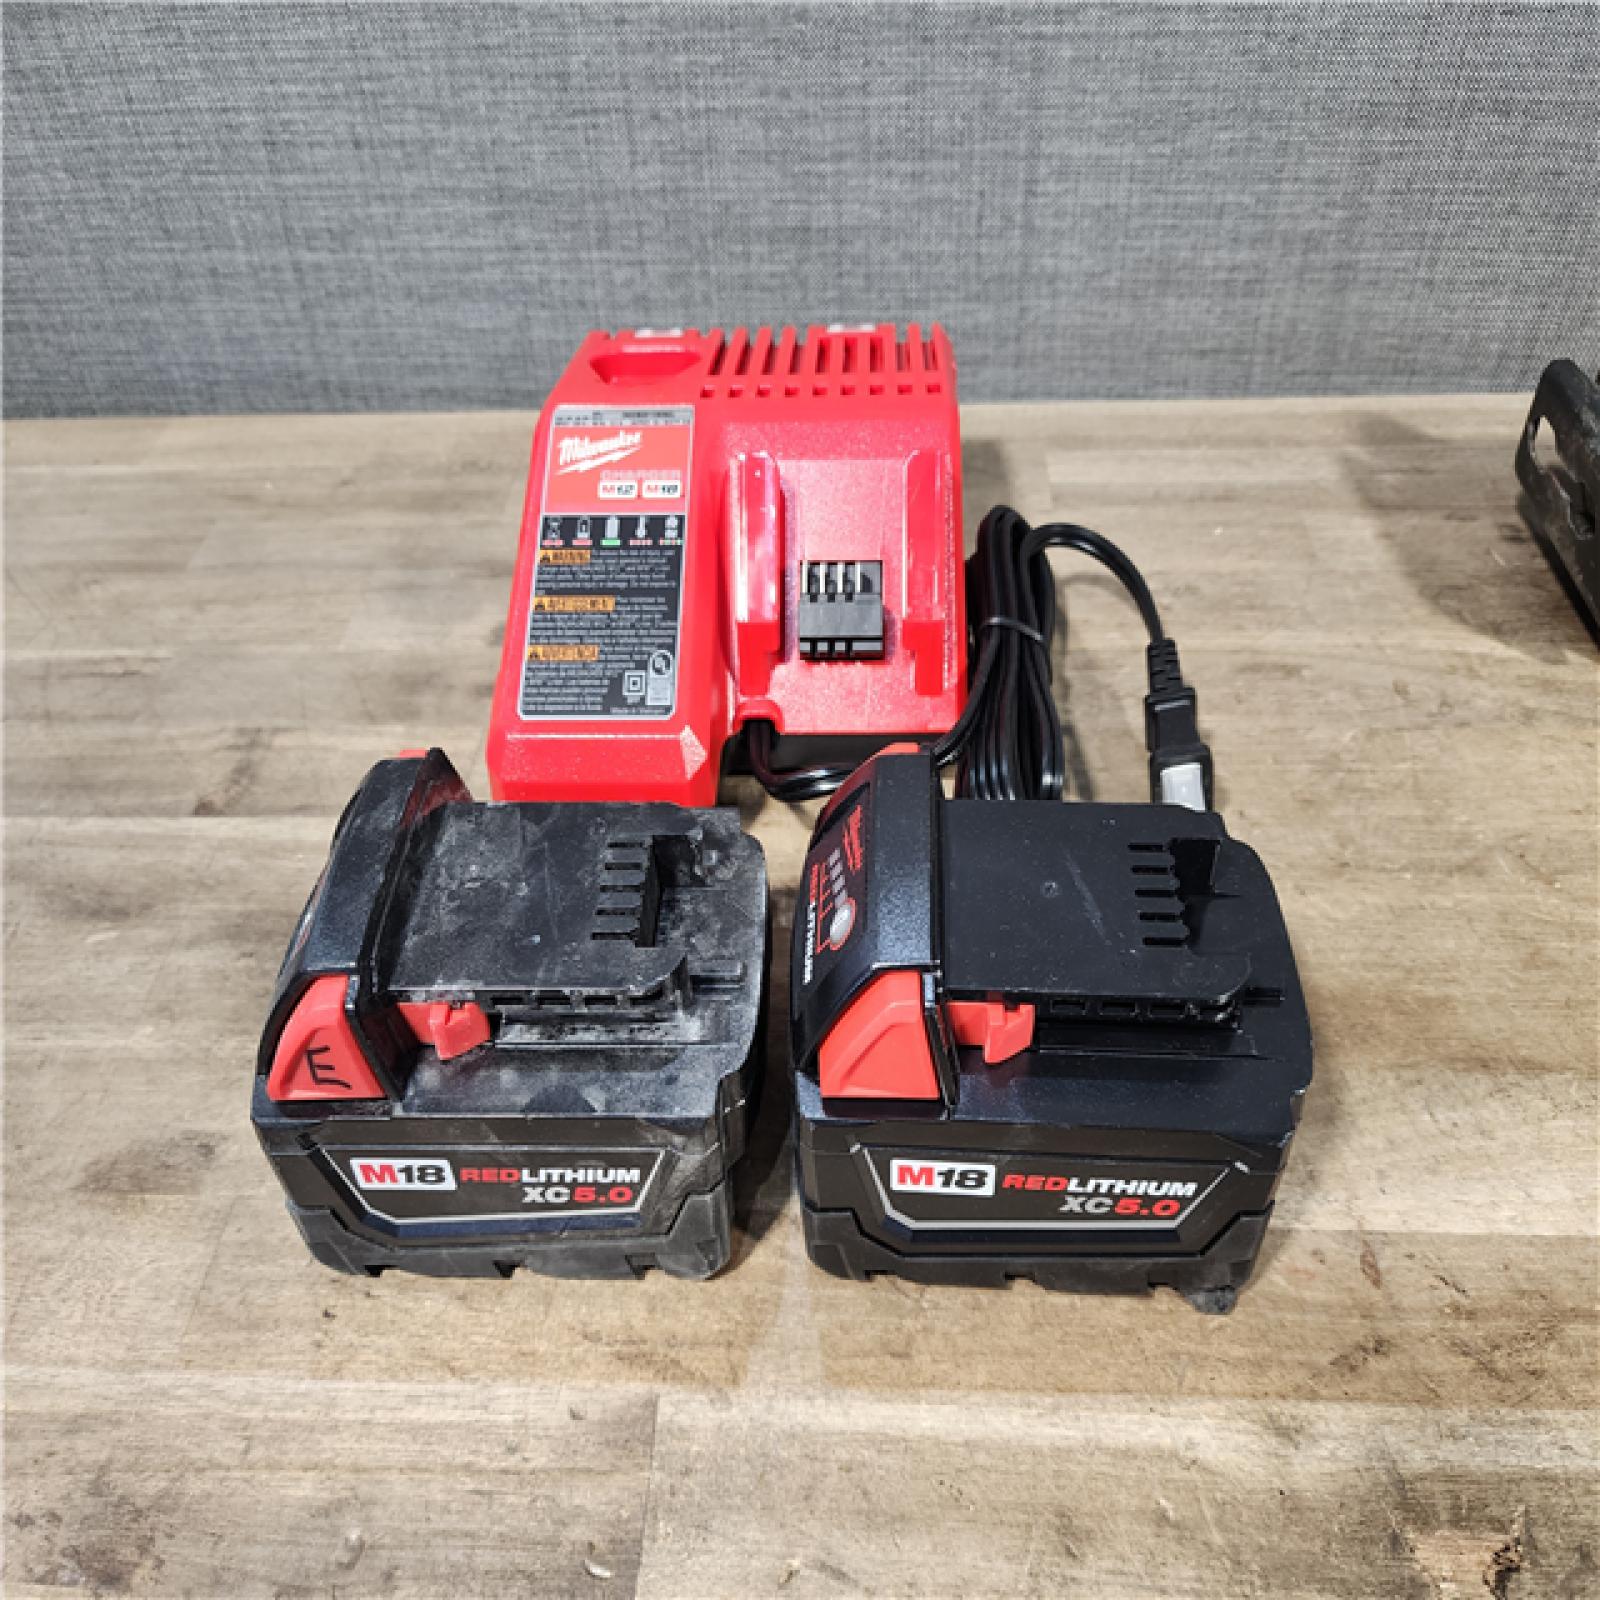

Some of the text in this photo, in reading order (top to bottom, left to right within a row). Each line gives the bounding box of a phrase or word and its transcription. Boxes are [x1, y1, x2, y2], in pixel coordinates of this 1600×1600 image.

[305, 1047, 352, 1089] E
[359, 1164, 641, 1184] M18 REDLITHIUM
[896, 1164, 1198, 1196] M18 REDLITHIUM
